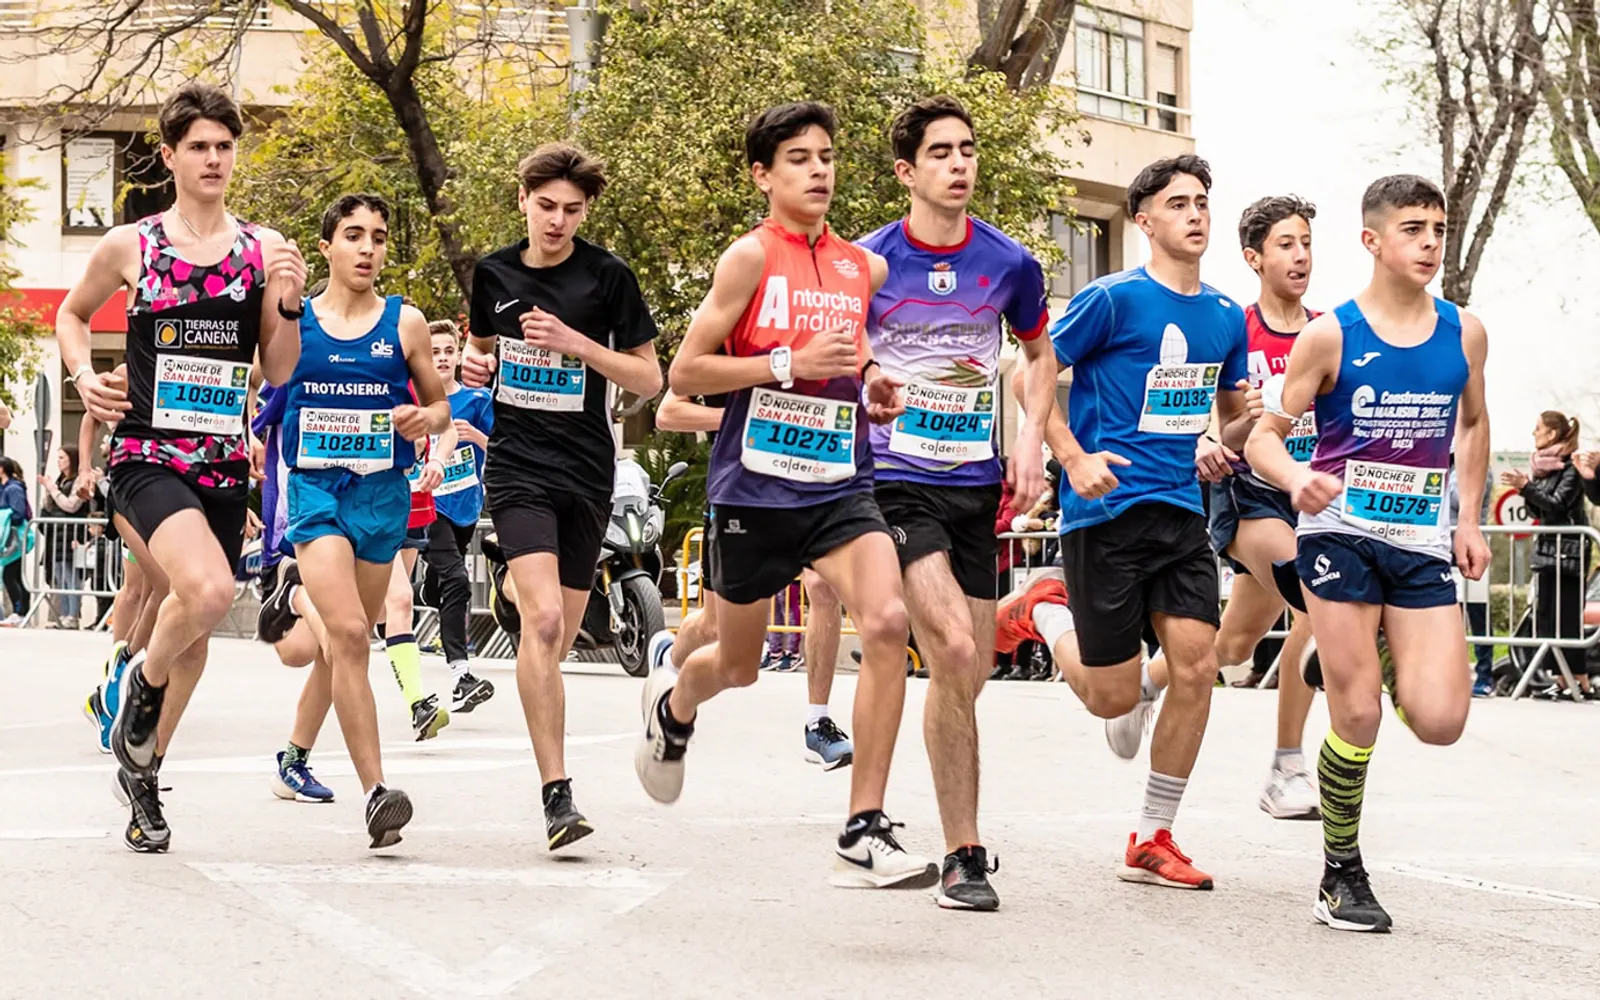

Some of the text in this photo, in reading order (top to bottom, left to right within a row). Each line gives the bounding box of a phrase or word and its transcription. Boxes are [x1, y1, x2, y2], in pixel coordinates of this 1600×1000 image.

[184, 319, 239, 331] TIERRAS DE
[184, 330, 239, 344] CANENA
[503, 352, 518, 362] SAN
[511, 345, 538, 357] NOCHE
[540, 349, 551, 357] DE
[163, 371, 184, 381] SAN
[176, 363, 208, 374] NOCHE
[210, 366, 223, 375] DE
[511, 365, 568, 386] 10116
[1164, 370, 1188, 379] NOCHE
[303, 381, 390, 395] TROTASIERRA
[1152, 380, 1169, 388] SAN
[175, 385, 236, 407] 10308
[515, 391, 558, 404] calderón
[905, 397, 929, 408] SAN
[920, 389, 955, 402] NOCHE
[956, 394, 968, 403] DE
[1161, 390, 1208, 407] 10132
[1380, 390, 1454, 405] Construcciones
[757, 408, 783, 420] SAN
[773, 399, 811, 414] NOCHE
[813, 406, 827, 416] DE
[181, 413, 225, 427] calderón
[317, 415, 347, 424] NOCHE
[348, 416, 360, 424] DE
[916, 411, 980, 432] 10424
[1302, 417, 1313, 426] DE
[306, 423, 325, 432] SAN
[317, 435, 377, 451] 10281
[767, 425, 840, 453] 10275
[1285, 437, 1318, 455] 043
[920, 441, 968, 456] calderón
[445, 463, 468, 478] 151
[773, 457, 826, 474] calderón
[1367, 469, 1402, 482] NOCHE
[1403, 473, 1416, 483] DE
[1353, 478, 1376, 489] SAN
[1364, 493, 1429, 515] 10579
[1508, 506, 1528, 521] 10
[1370, 524, 1417, 538] calderón
